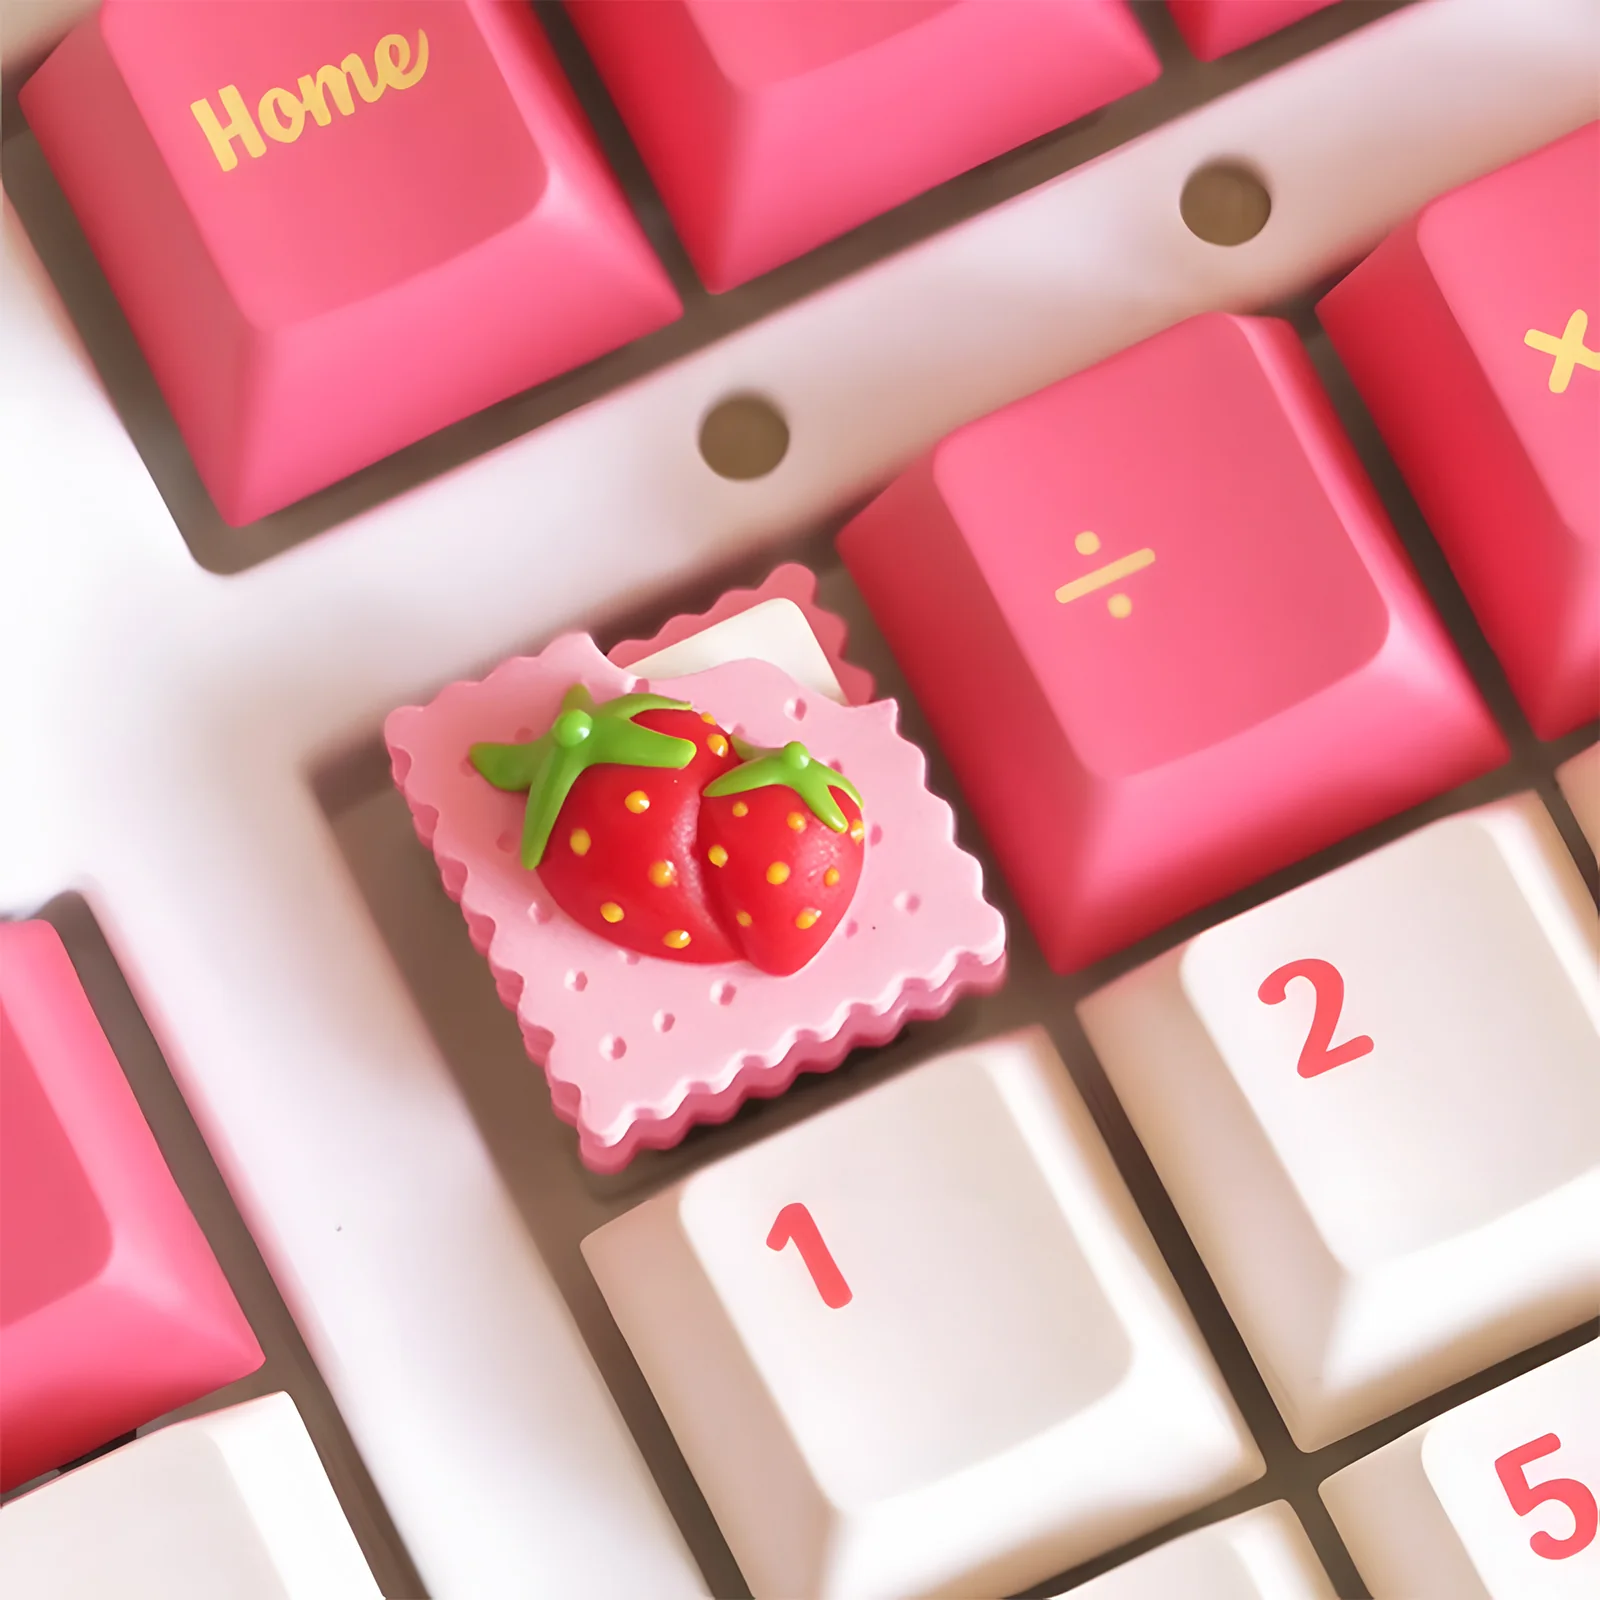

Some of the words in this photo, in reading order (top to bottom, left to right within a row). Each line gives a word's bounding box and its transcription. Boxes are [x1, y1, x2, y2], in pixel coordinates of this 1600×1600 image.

[190, 28, 429, 172] Home
[1257, 957, 1375, 1079] 2
[765, 1202, 853, 1309] 1
[1494, 1432, 1600, 1560] 5
